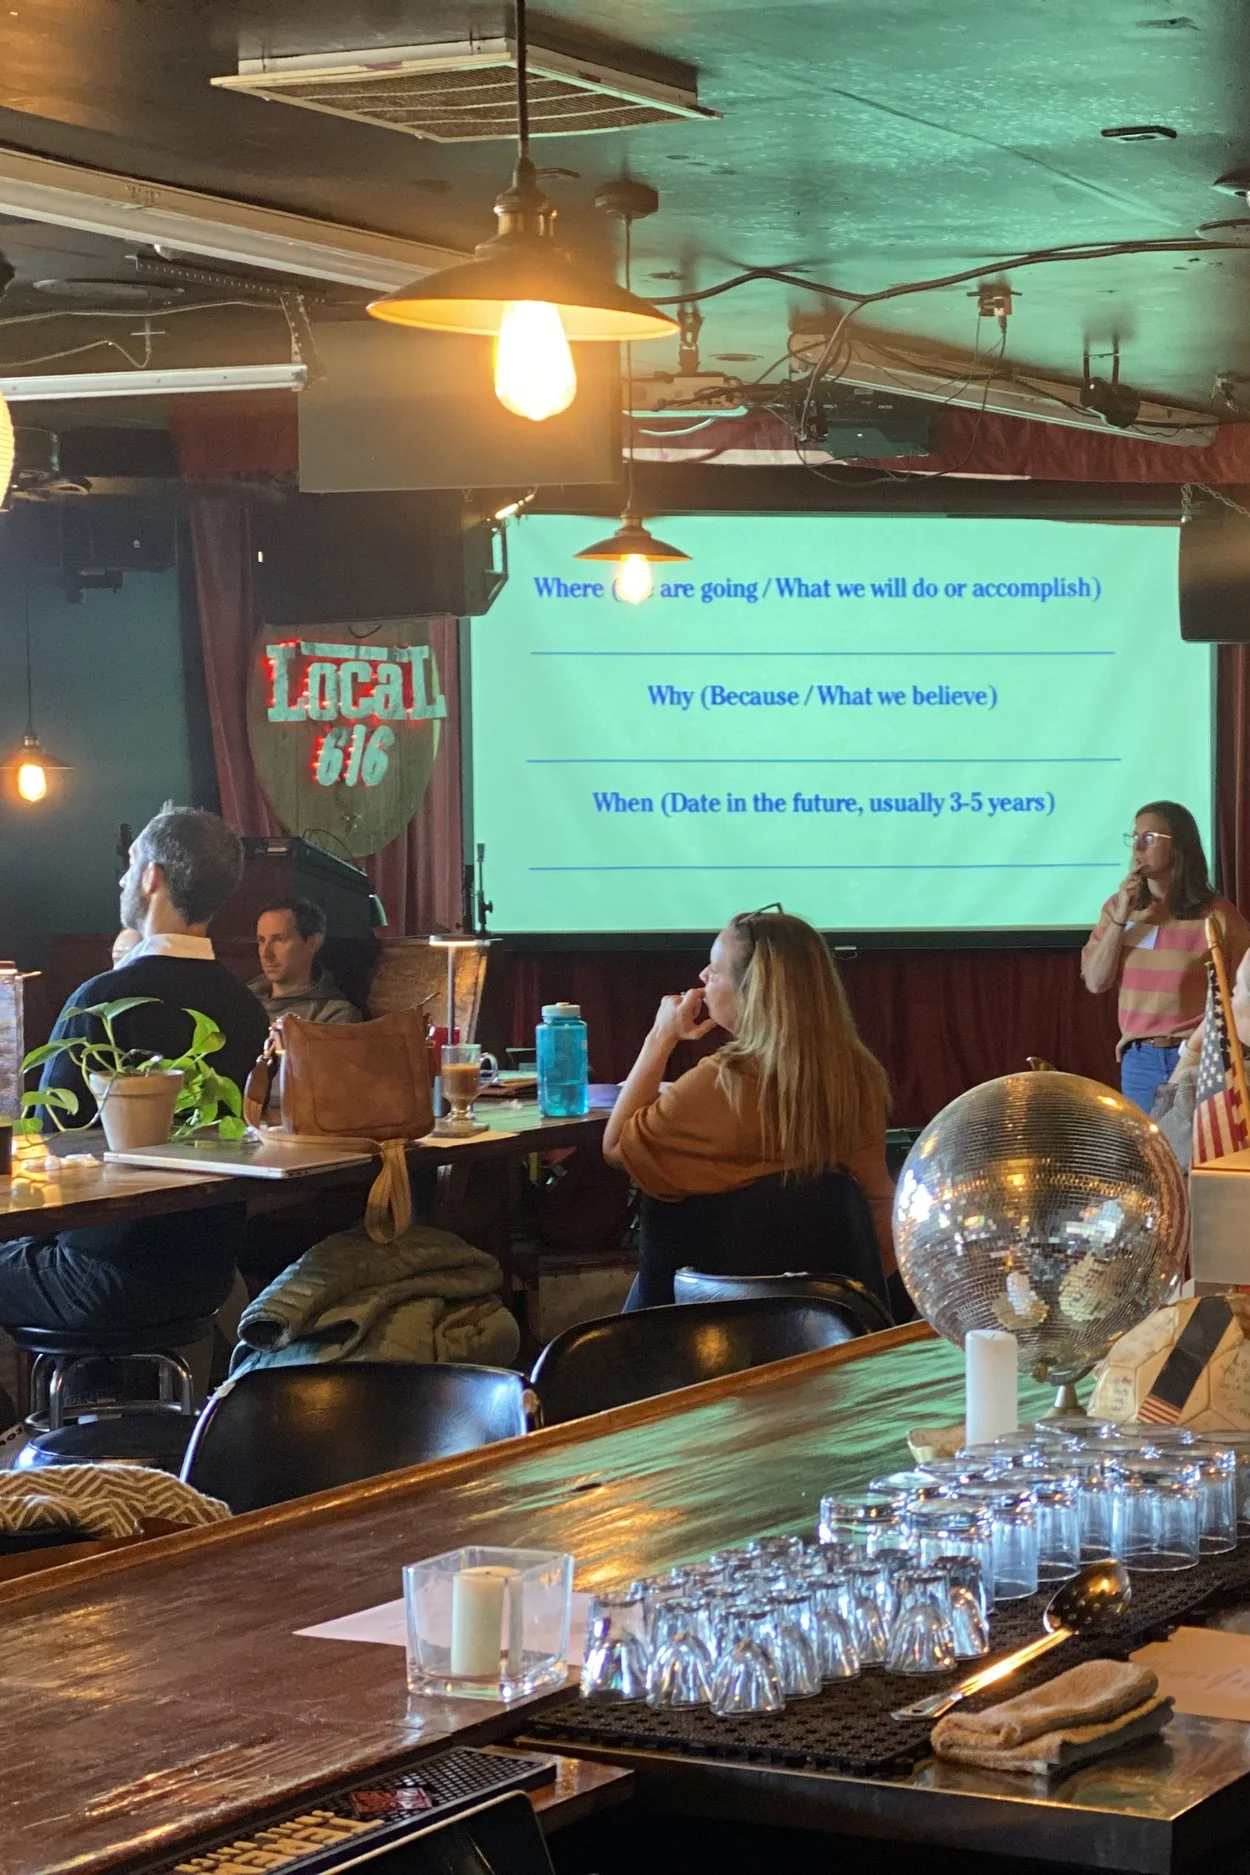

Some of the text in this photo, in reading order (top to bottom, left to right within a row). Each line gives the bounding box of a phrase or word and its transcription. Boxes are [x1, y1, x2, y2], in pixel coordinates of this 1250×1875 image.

[533, 576, 604, 599] Where
[659, 582, 695, 599] are
[700, 577, 759, 604] going
[835, 582, 866, 599] we
[869, 576, 907, 599] will
[912, 576, 939, 599] do
[943, 582, 968, 598] or
[971, 576, 1102, 603] accomplish)
[647, 684, 695, 712] Why
[700, 684, 800, 711] (Because
[876, 690, 907, 706] we
[911, 684, 998, 711] believe)
[315, 723, 396, 787] 616
[591, 791, 1056, 818] When (Date in the future, usually 3-5 years)
